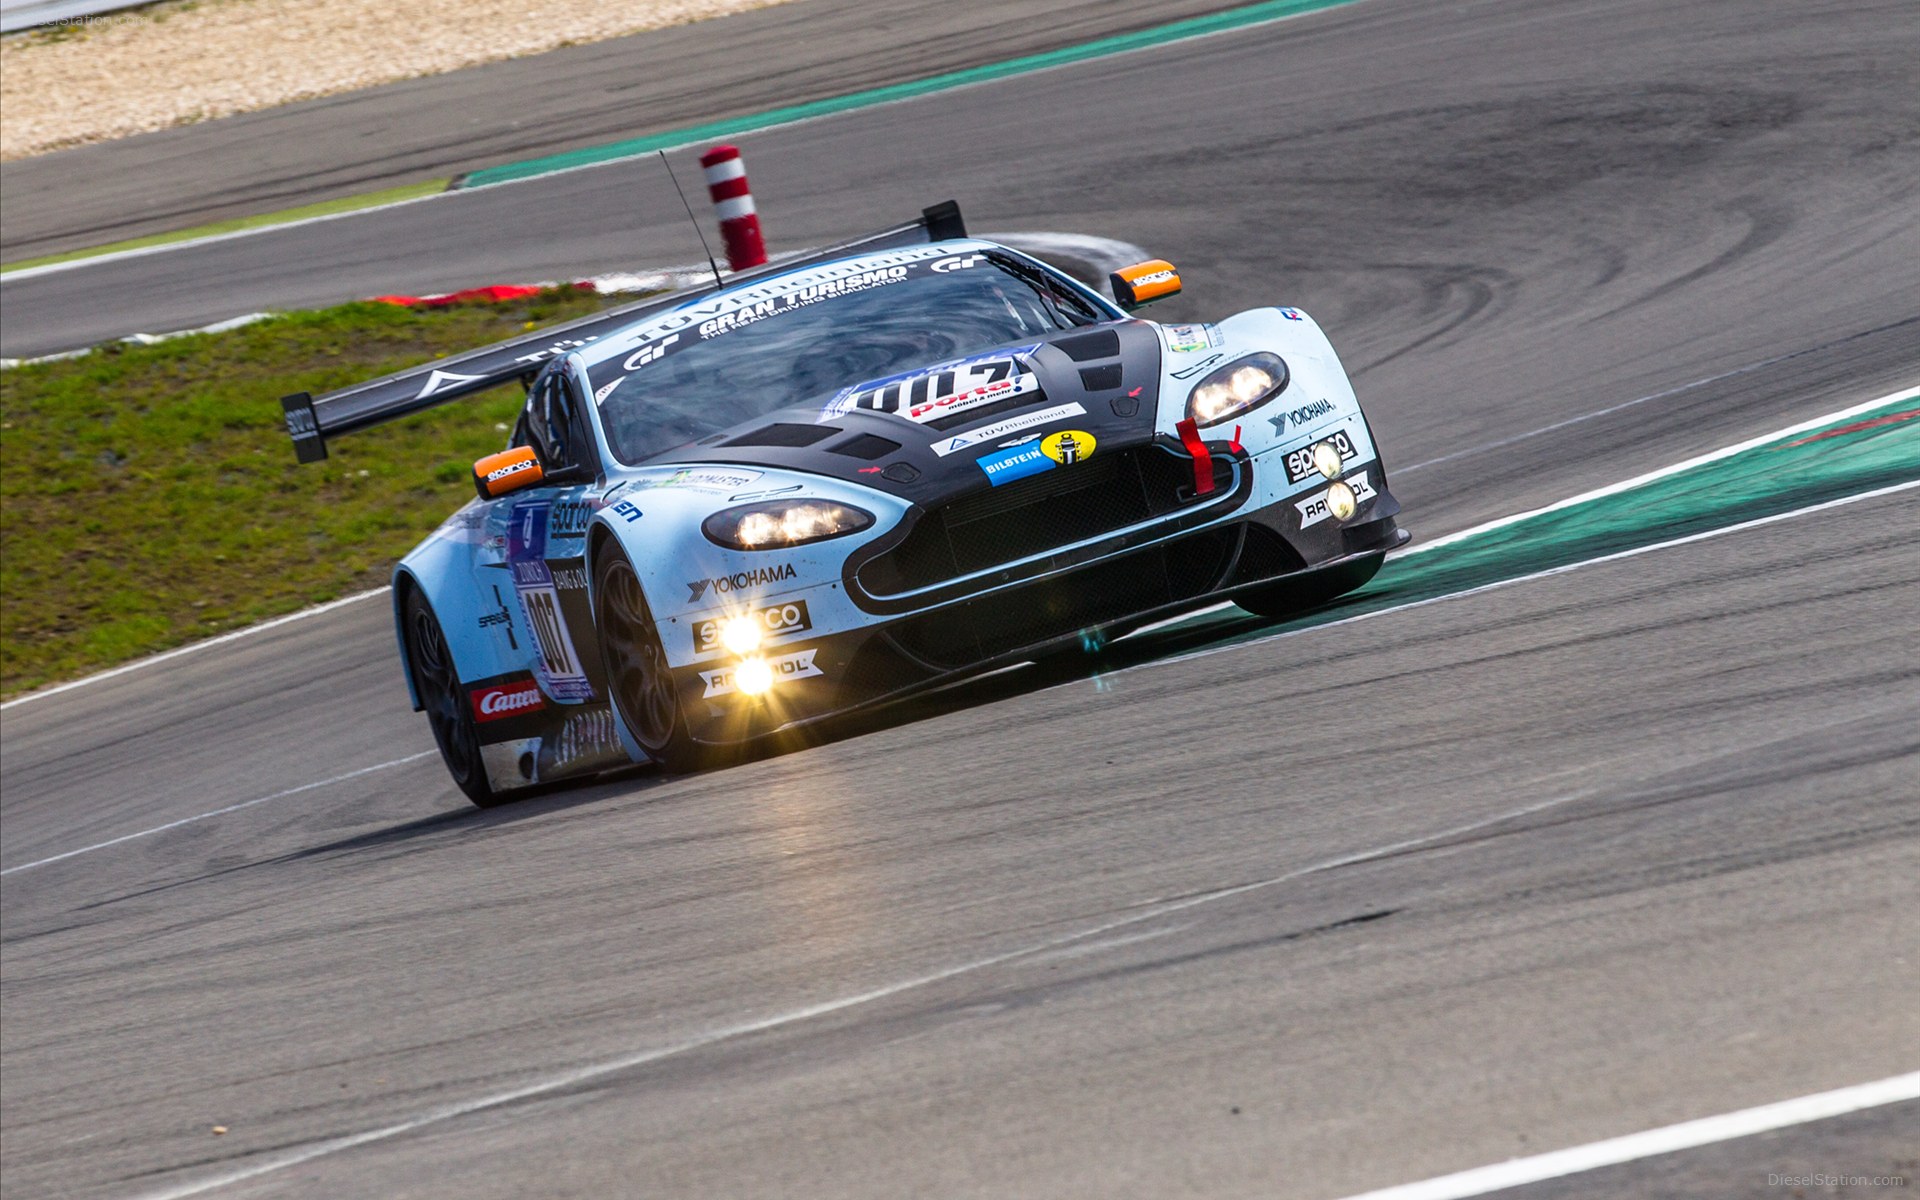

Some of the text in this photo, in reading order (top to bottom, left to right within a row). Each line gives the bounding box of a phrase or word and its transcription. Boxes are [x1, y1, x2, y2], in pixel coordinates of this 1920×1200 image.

[699, 265, 907, 336] GRAN TURISMO
[701, 276, 908, 341] THE REAL DRIVING SIMULATOR
[948, 397, 978, 411] möbel
[987, 387, 1012, 399] mehr
[487, 459, 533, 482] sparco
[985, 449, 1042, 475] BILSTEIN
[712, 563, 797, 594] YOKOHAMA
